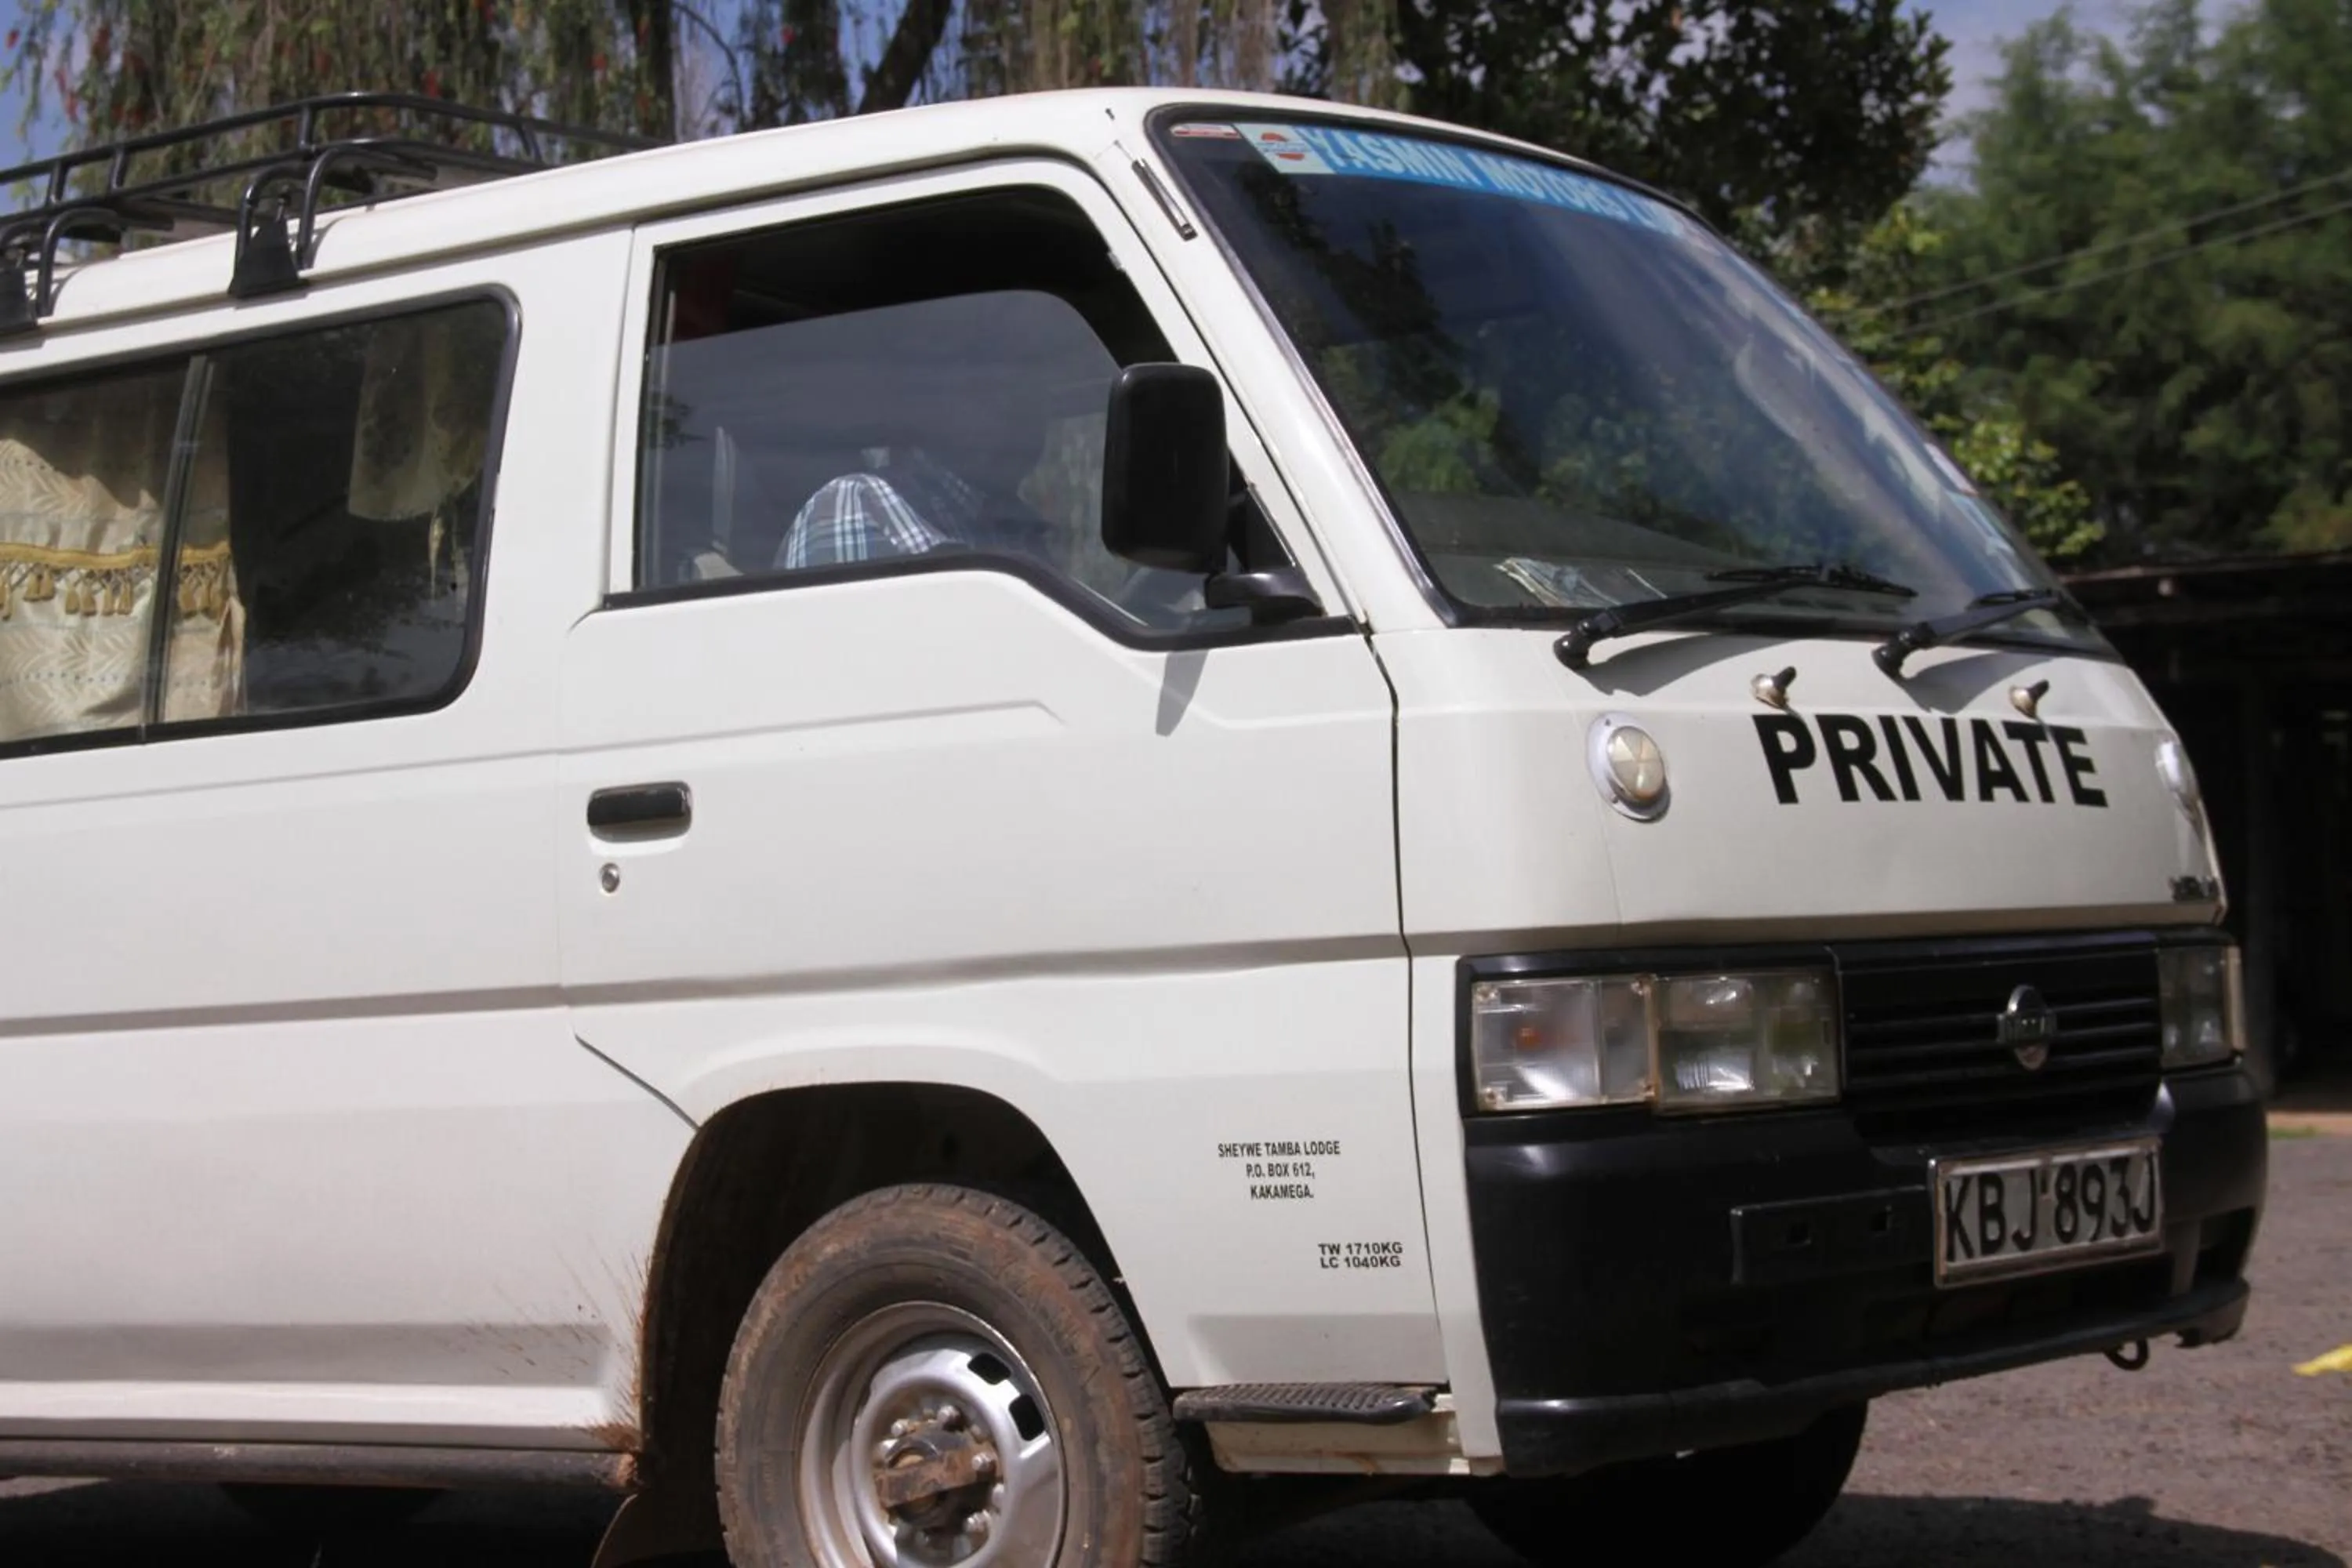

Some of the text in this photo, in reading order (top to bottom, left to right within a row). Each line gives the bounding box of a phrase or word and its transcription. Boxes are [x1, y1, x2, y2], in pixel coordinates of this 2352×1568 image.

[1297, 129, 1483, 187] YASMIN
[1468, 152, 1630, 222] MOTORS
[1752, 714, 2107, 807] PRIVATE
[1218, 1140, 1341, 1158] SHEYWE TAMBA LODGE
[1246, 1162, 1316, 1179] P.O. BOX 612,
[1250, 1184, 1314, 1200] KAKAMEGA.
[1945, 1152, 2154, 1263] KBJ 893J
[1318, 1242, 1403, 1255] TW 1710KG
[1320, 1255, 1401, 1269] LC 1040KG
